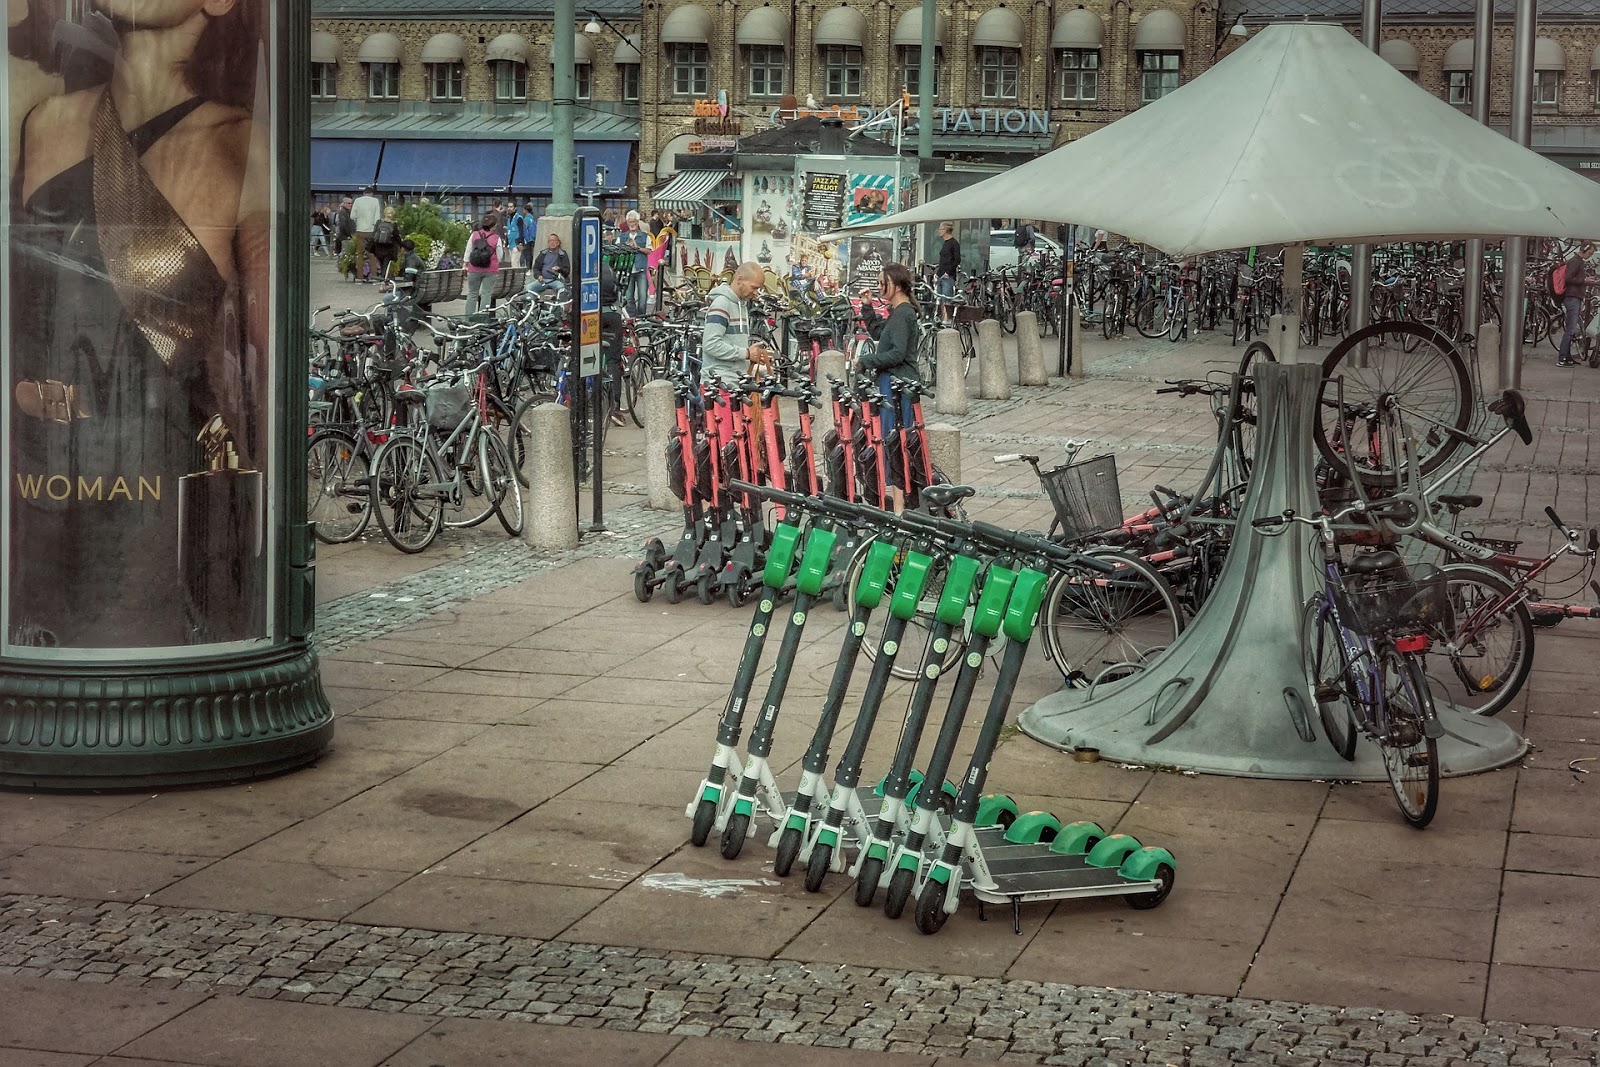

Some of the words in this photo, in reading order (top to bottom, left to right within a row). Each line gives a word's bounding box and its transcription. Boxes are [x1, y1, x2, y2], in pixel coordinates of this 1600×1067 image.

[813, 177, 828, 185] JAZZ
[585, 224, 596, 274] P
[17, 473, 161, 500] WOMAN
[1444, 535, 1482, 554] CALVIN
